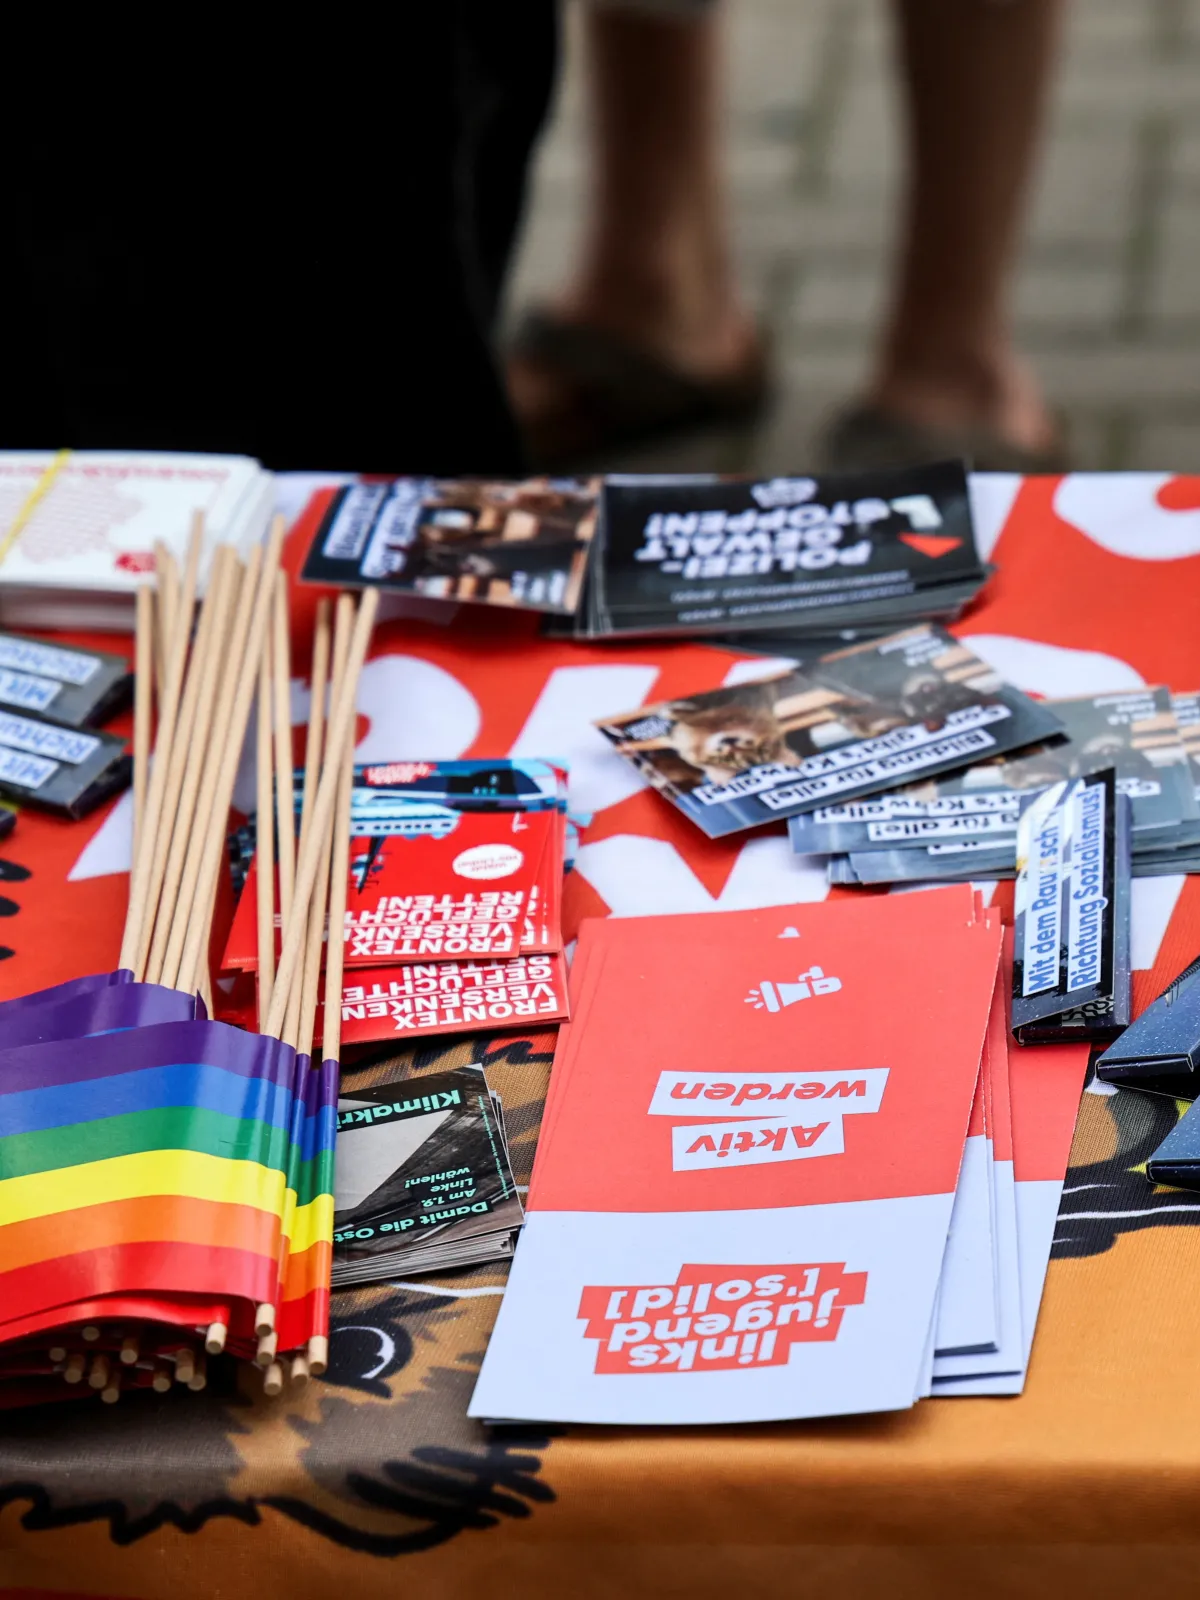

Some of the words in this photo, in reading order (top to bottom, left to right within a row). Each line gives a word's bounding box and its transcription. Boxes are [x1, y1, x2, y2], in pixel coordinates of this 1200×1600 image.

[644, 498, 891, 538] STOPPEN!
[634, 525, 843, 562] GEWALT
[661, 541, 873, 580] POLIZEI-
[0, 719, 90, 758] Richtu
[838, 731, 917, 760] gibt's
[879, 731, 983, 772] Bildung
[836, 760, 871, 785] für
[771, 774, 828, 805] alle!
[872, 821, 940, 839] alle!
[949, 817, 991, 835] für
[1072, 789, 1104, 899] Sozialismus!
[377, 890, 525, 913] RETTEN!
[338, 905, 520, 930] GEFLÜCHT
[338, 922, 513, 942] VERSENK
[350, 936, 514, 957] FRONTEX
[1037, 911, 1057, 959] dem
[1070, 897, 1109, 989] Richtung
[341, 966, 552, 1006] GEFLÜCHTE
[1027, 964, 1057, 993] Mit
[341, 982, 557, 1021] VERSENKEN
[392, 998, 559, 1031] FRONTEX
[337, 1089, 461, 1129] Klimakri
[669, 1080, 868, 1107] werden
[685, 1122, 831, 1156] Aktiv
[404, 1167, 471, 1188] wählen!
[430, 1178, 474, 1194] Linke
[449, 1188, 477, 1200] Am
[379, 1218, 415, 1235] die
[419, 1201, 489, 1227] Damit
[333, 1227, 375, 1243] Ost
[605, 1268, 819, 1320] ['solid]
[607, 1289, 838, 1352] jugend
[628, 1330, 777, 1371] links
